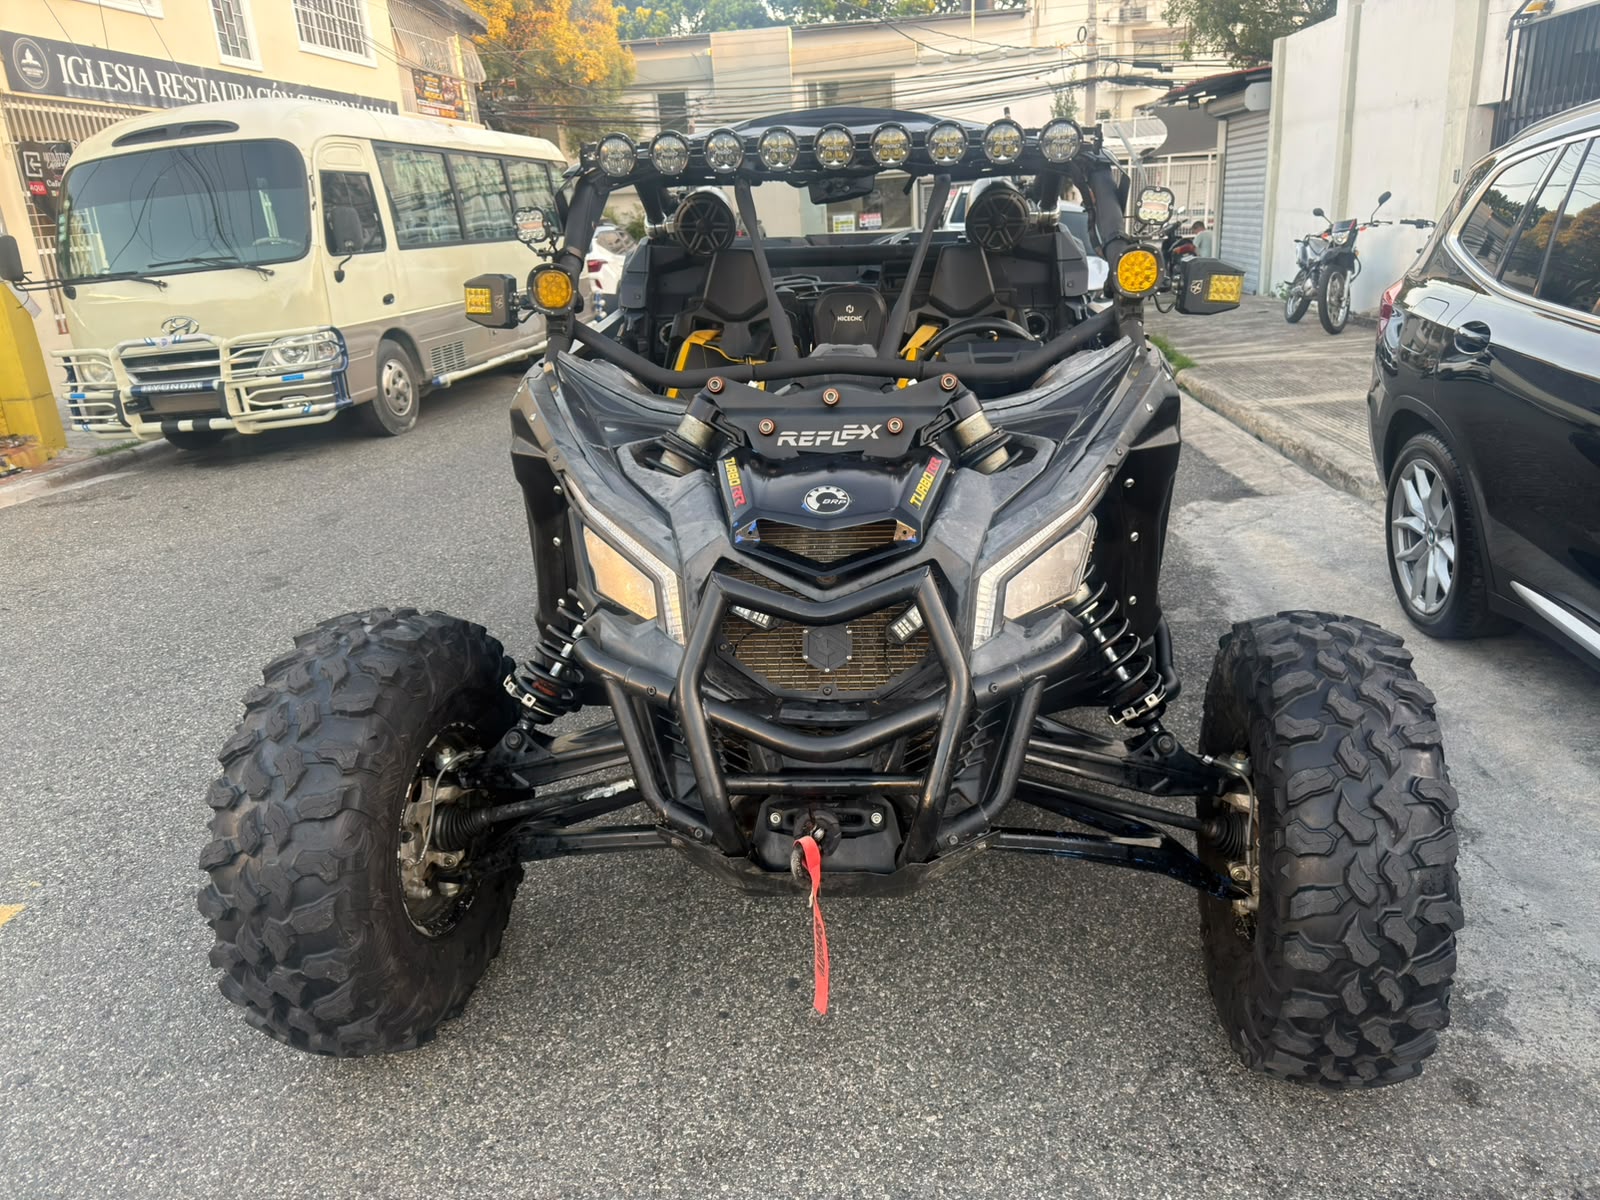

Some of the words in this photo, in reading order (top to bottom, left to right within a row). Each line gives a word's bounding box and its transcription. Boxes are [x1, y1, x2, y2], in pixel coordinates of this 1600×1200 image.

[57, 53, 156, 96] IGLESIA
[140, 382, 203, 392] HYUNDAI
[777, 424, 882, 446] REFLEX
